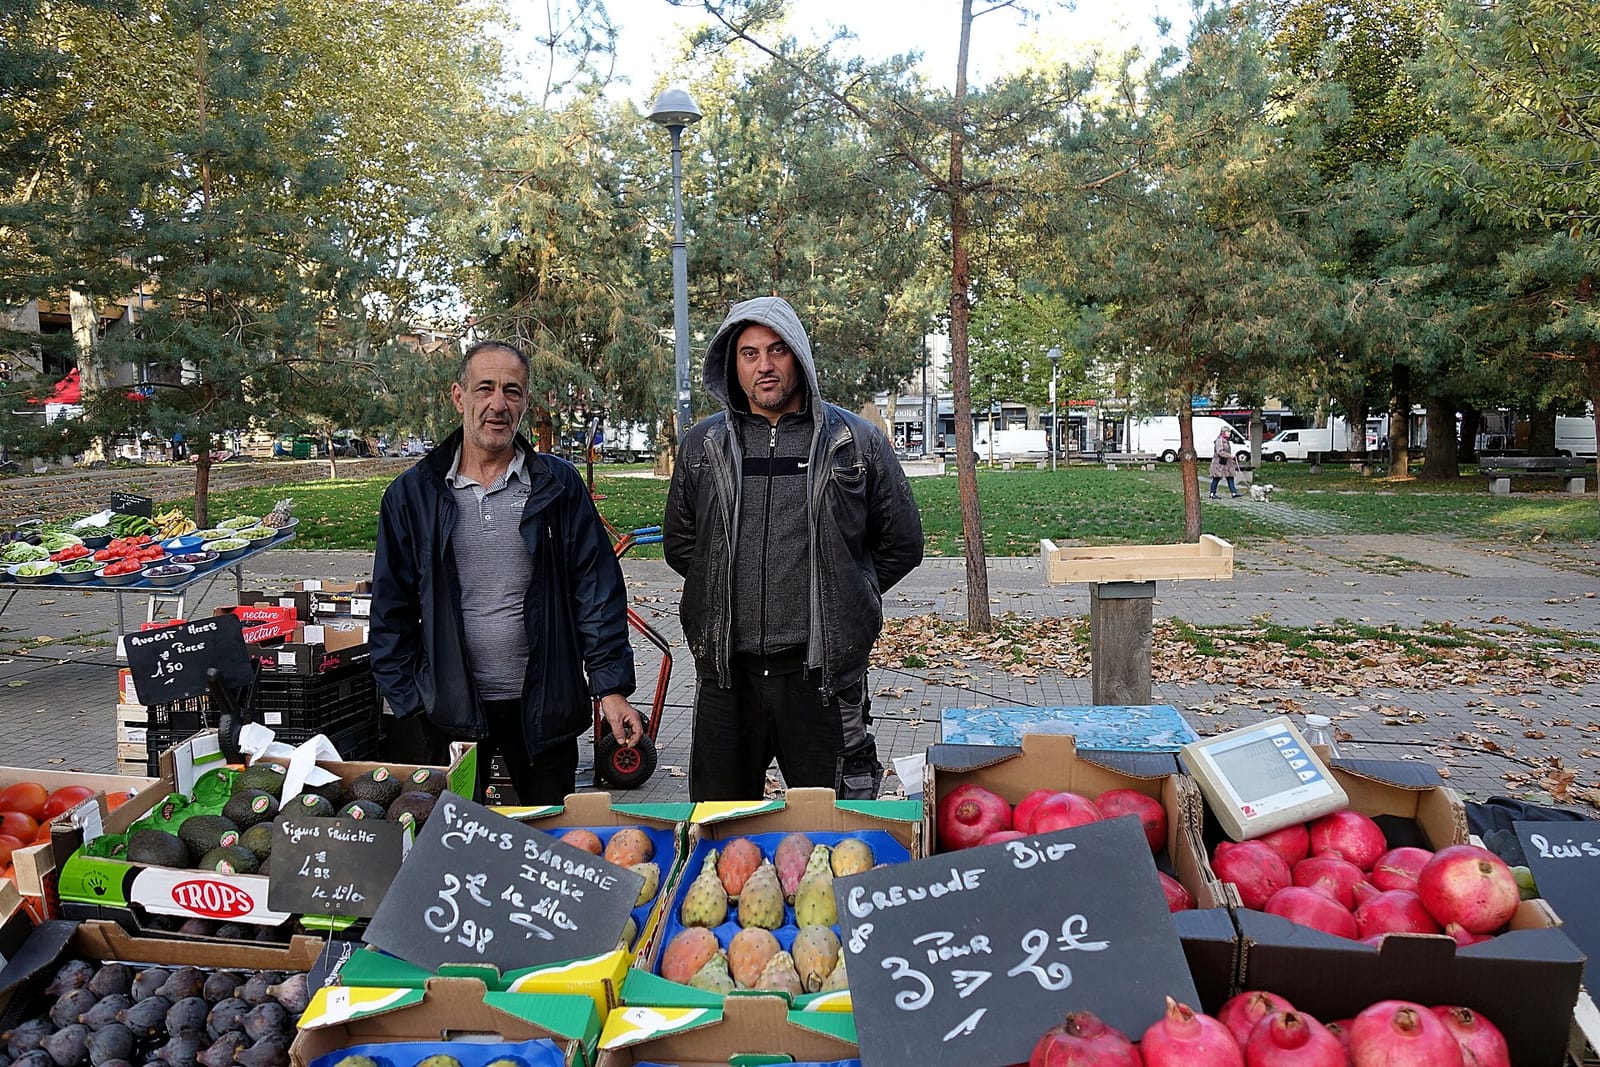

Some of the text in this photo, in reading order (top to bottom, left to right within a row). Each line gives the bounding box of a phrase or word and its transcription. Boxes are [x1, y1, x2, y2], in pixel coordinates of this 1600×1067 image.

[242, 609, 280, 620] nectare
[1005, 840, 1077, 869] Bio
[1530, 833, 1600, 859] Rais
[175, 882, 251, 912] TROPS
[881, 956, 935, 1011] 3
